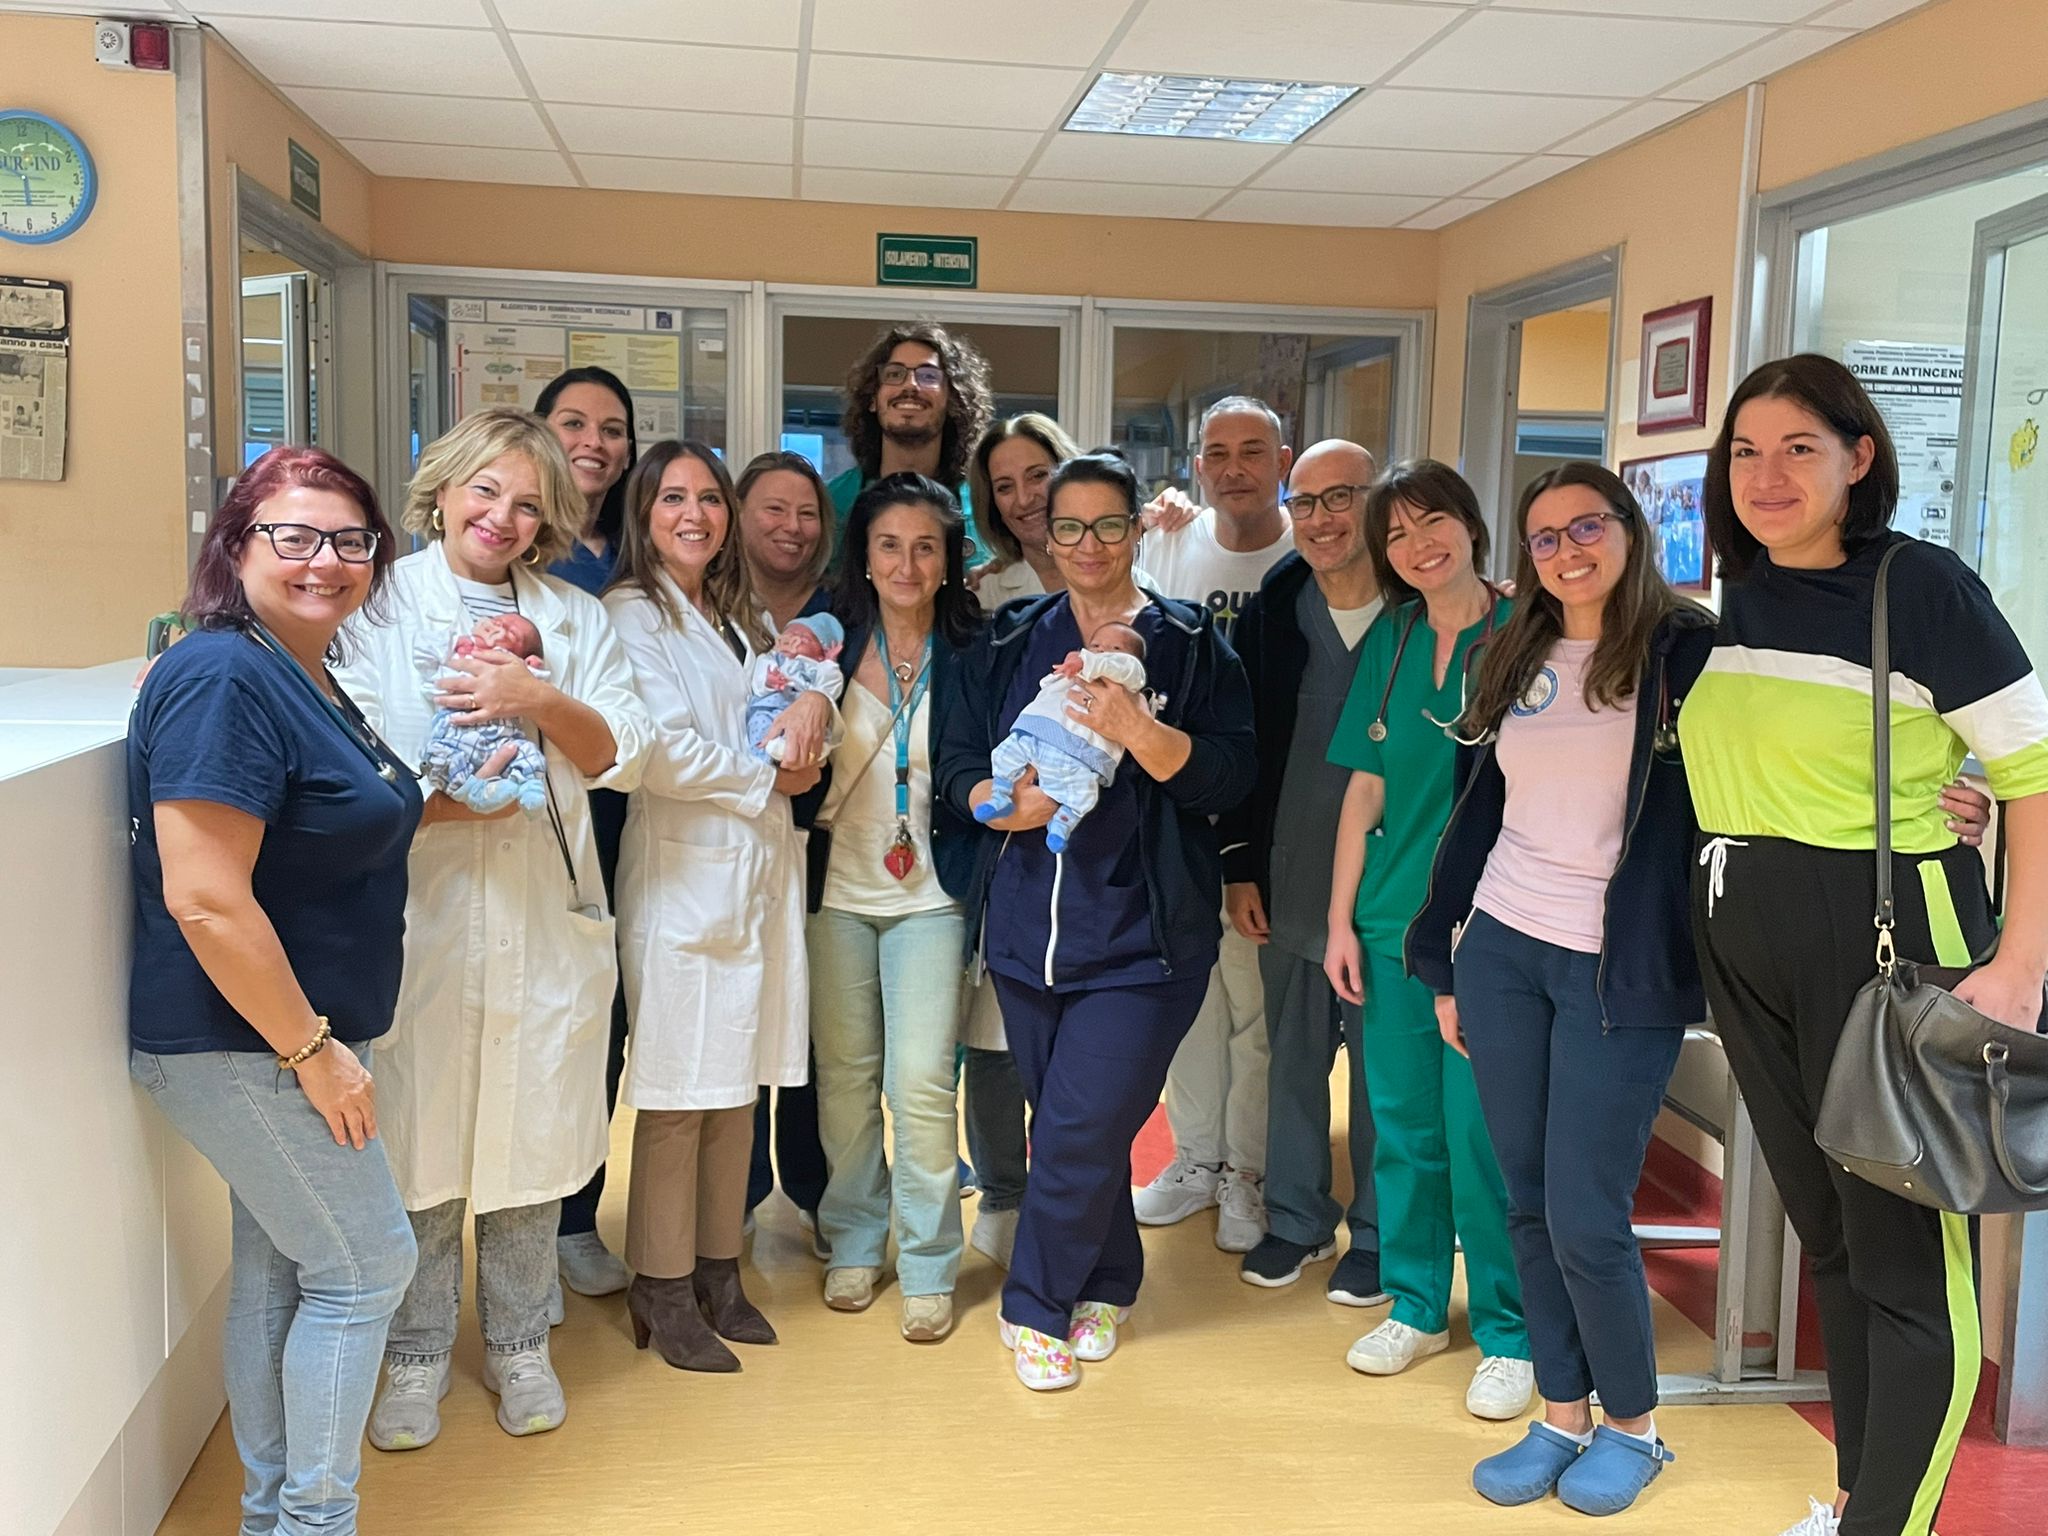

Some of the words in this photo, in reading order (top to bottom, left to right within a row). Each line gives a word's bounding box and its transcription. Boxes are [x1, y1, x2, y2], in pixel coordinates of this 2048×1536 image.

[17, 123, 27, 137] 12
[65, 150, 73, 163] 2
[73, 173, 80, 185] 3
[69, 195, 75, 208] 4
[2, 211, 8, 225] 7
[26, 217, 33, 231] 6
[51, 211, 58, 225] 5
